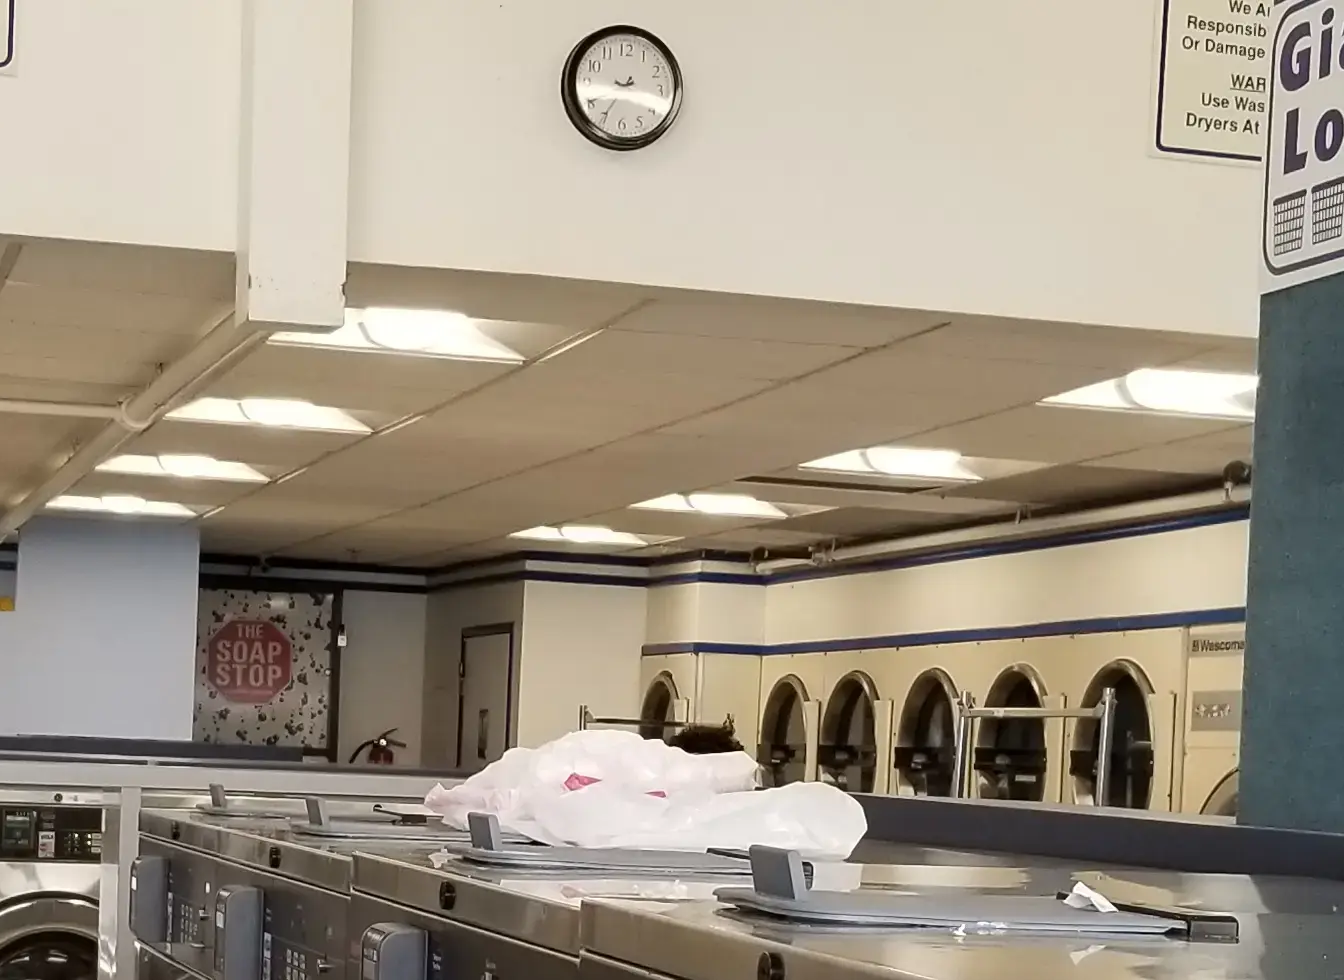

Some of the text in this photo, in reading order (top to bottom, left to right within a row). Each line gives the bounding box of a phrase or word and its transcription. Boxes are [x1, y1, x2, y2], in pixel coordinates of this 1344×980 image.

[1229, 0, 1251, 14] We
[1187, 15, 1267, 38] Responsib
[602, 46, 612, 60] 11
[619, 43, 633, 57] 12
[1182, 36, 1265, 60] Or Damage
[588, 60, 601, 73] 10
[652, 65, 660, 78] 2
[1201, 92, 1265, 113] Use Was
[617, 117, 627, 130] 6
[635, 115, 644, 128] 5
[1186, 112, 1260, 134] Dryers At
[236, 623, 265, 639] THE
[216, 639, 283, 664] SOAP
[216, 663, 283, 687] STOP
